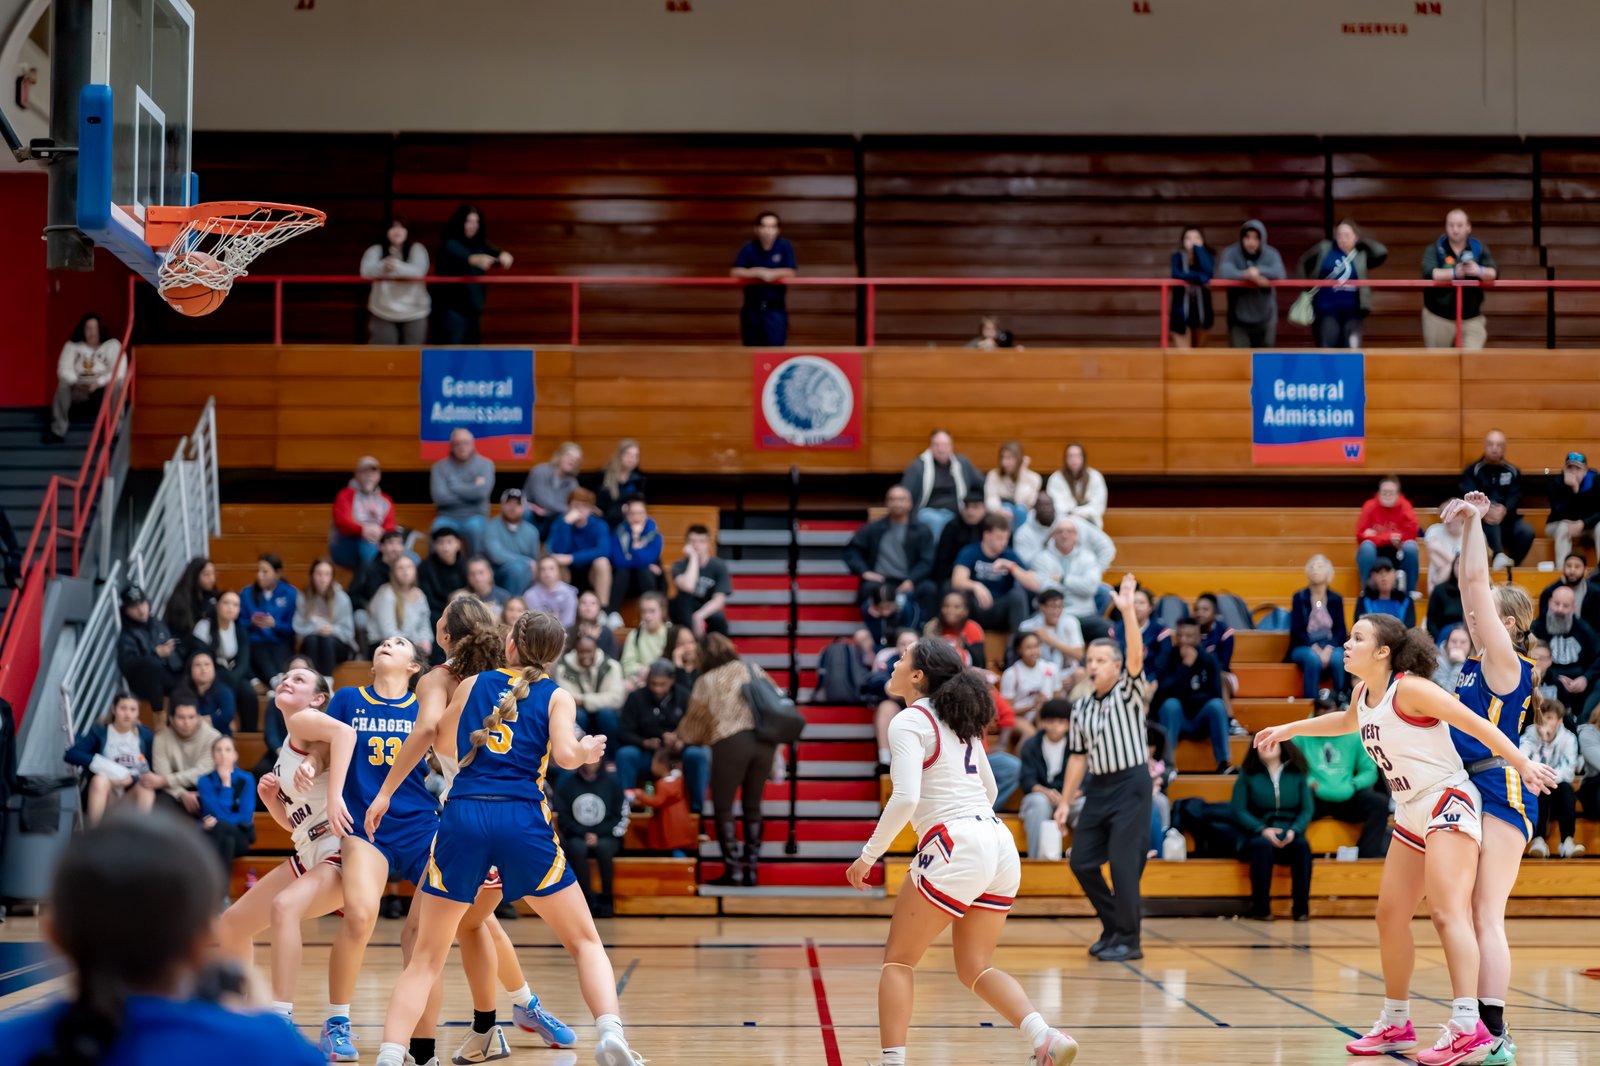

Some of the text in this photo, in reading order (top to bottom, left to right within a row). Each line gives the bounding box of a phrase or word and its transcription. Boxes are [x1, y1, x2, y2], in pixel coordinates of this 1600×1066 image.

[441, 375, 513, 398] General
[1274, 378, 1344, 401] General
[430, 401, 523, 424] Admission
[1262, 404, 1355, 427] Admission
[1343, 443, 1361, 459] W
[351, 717, 415, 734] CHARGER
[486, 706, 519, 754] 5
[368, 736, 403, 766] 33
[1388, 775, 1412, 792] ORA
[288, 803, 313, 829] ORA
[1443, 813, 1462, 823] W
[918, 852, 935, 870] W
